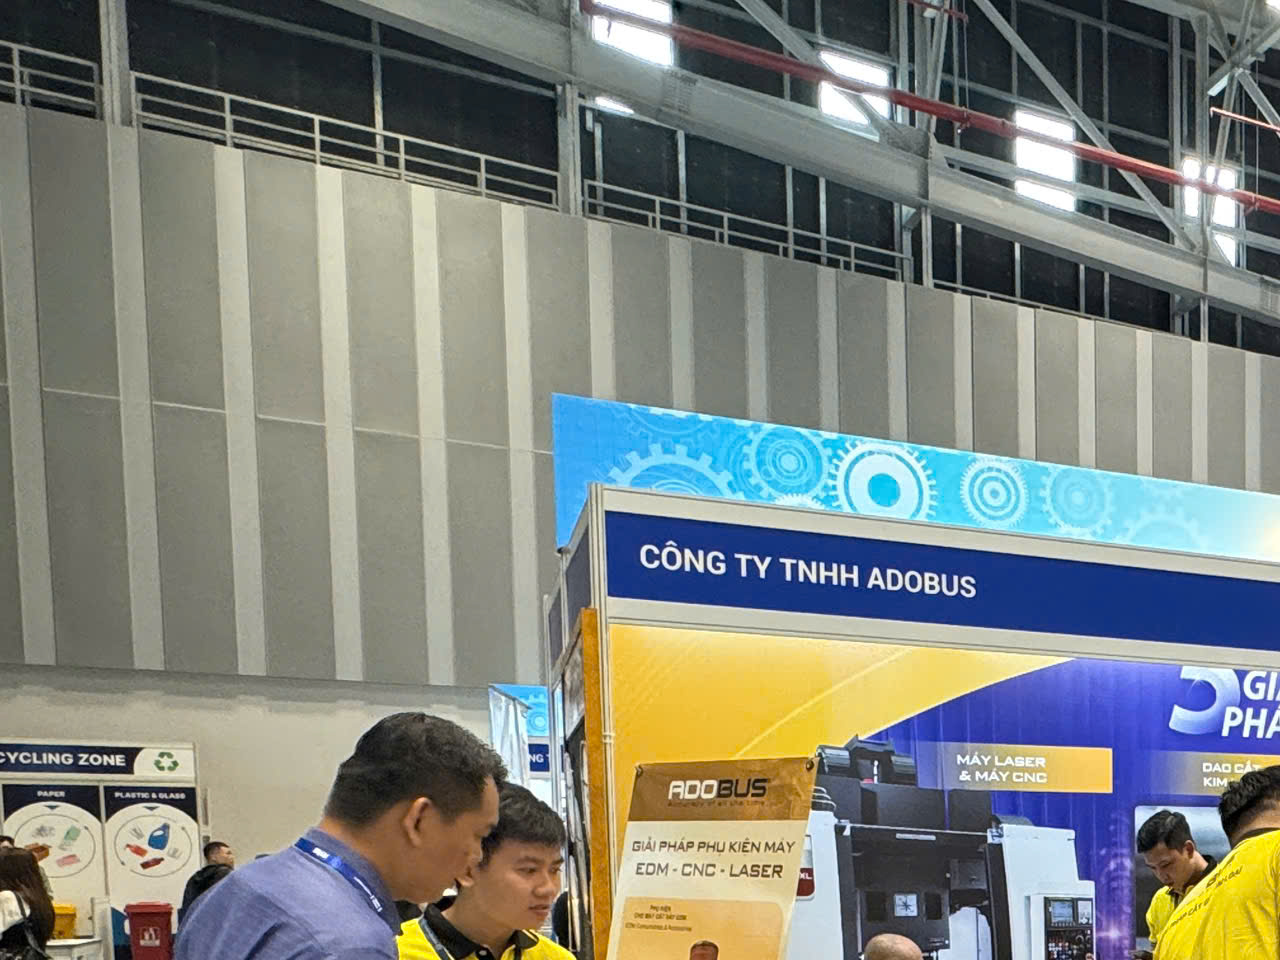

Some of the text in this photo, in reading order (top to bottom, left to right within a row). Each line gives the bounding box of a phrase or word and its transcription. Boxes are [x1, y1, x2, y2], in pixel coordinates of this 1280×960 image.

[640, 540, 977, 598] CÔNG TY TNHH ADOBUS
[78, 753, 127, 767] ZONE
[956, 752, 1047, 768] MÁY LASER
[1202, 762, 1232, 774] DAO
[959, 768, 1048, 784] & MÁY CNC
[1203, 777, 1228, 788] KIM
[37, 790, 66, 798] PAPER
[667, 777, 769, 800] ADOBUS
[632, 836, 656, 852] GIẢI
[659, 836, 695, 852] PHÁP
[697, 841, 726, 857] PHỤ
[764, 836, 796, 854] MÁY
[635, 862, 669, 876] EDM
[681, 863, 717, 877] CNC
[728, 863, 784, 879] LASER
